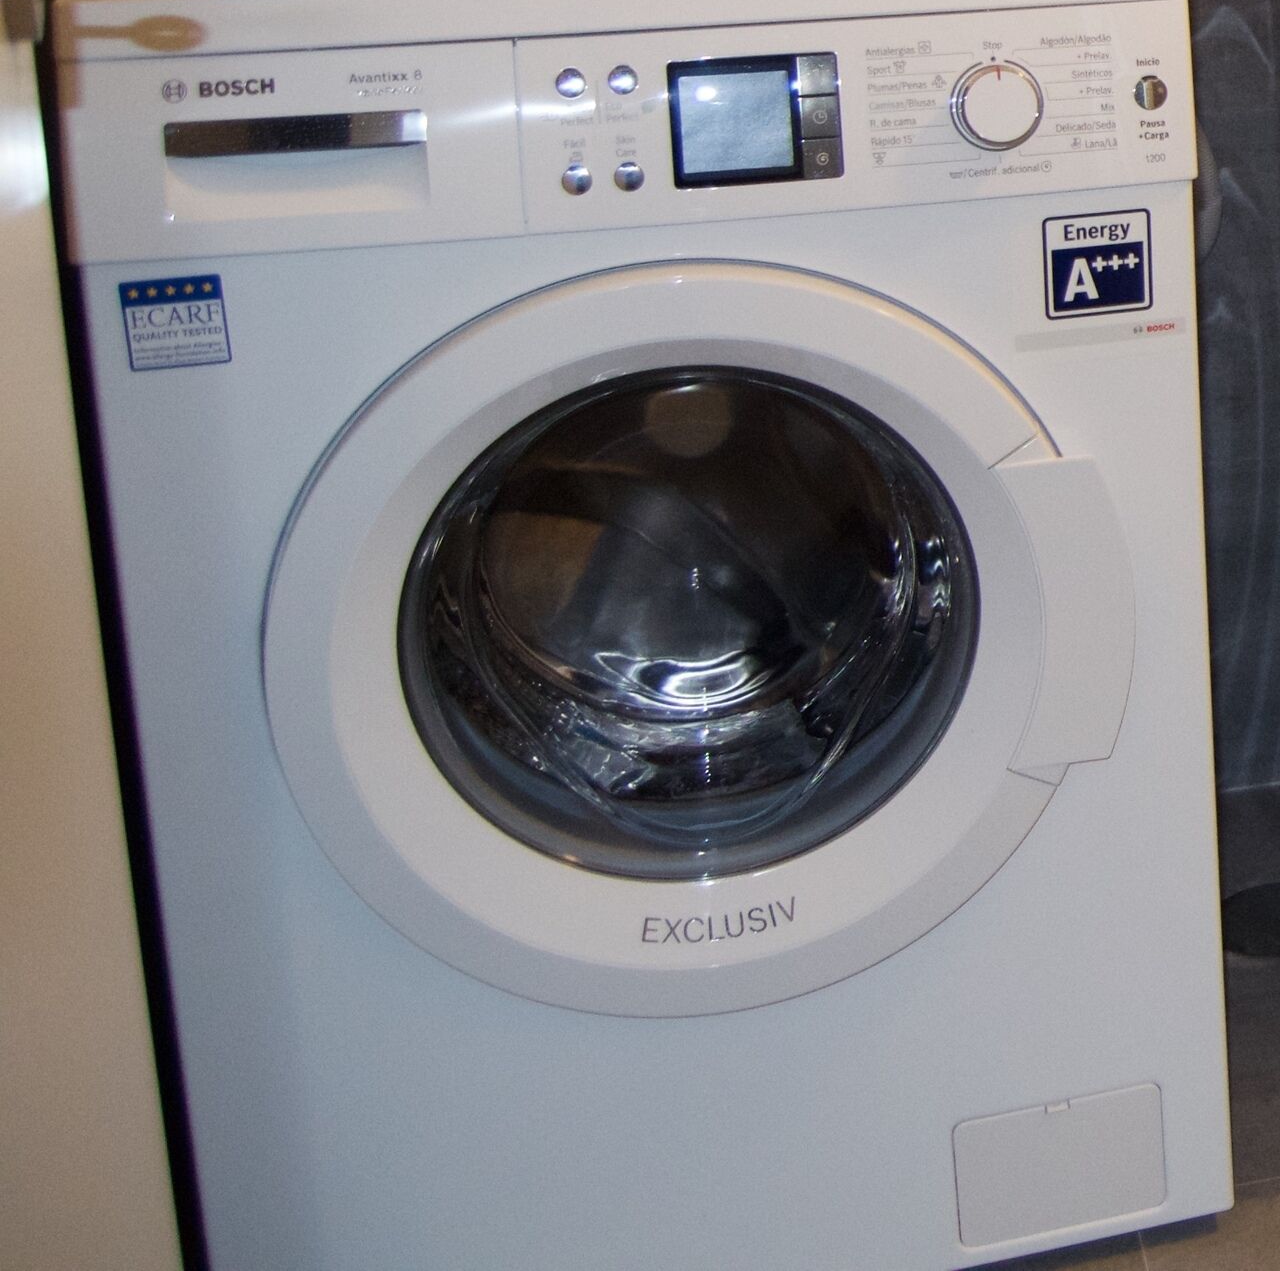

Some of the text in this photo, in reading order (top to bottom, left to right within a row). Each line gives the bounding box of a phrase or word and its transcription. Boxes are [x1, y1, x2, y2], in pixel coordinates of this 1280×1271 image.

[982, 40, 1002, 52] Stop
[866, 65, 892, 76] Sport
[1071, 68, 1113, 80] Sintéticos
[349, 72, 408, 84] Avantixx
[198, 78, 275, 98] BOSCH
[1100, 103, 1116, 112] Mix
[881, 119, 892, 128] de
[893, 117, 917, 128] cama
[1055, 120, 1117, 133] Delicado/Seda
[1140, 119, 1166, 128] Pausa
[1001, 163, 1040, 176] adicional
[1063, 222, 1131, 242] Energy
[1063, 252, 1140, 303] A+++
[131, 303, 220, 330] ECARF
[1146, 322, 1176, 333] BOSCH
[132, 326, 223, 345] QUALITY TESTED
[641, 895, 797, 944] EXCLUSIV
